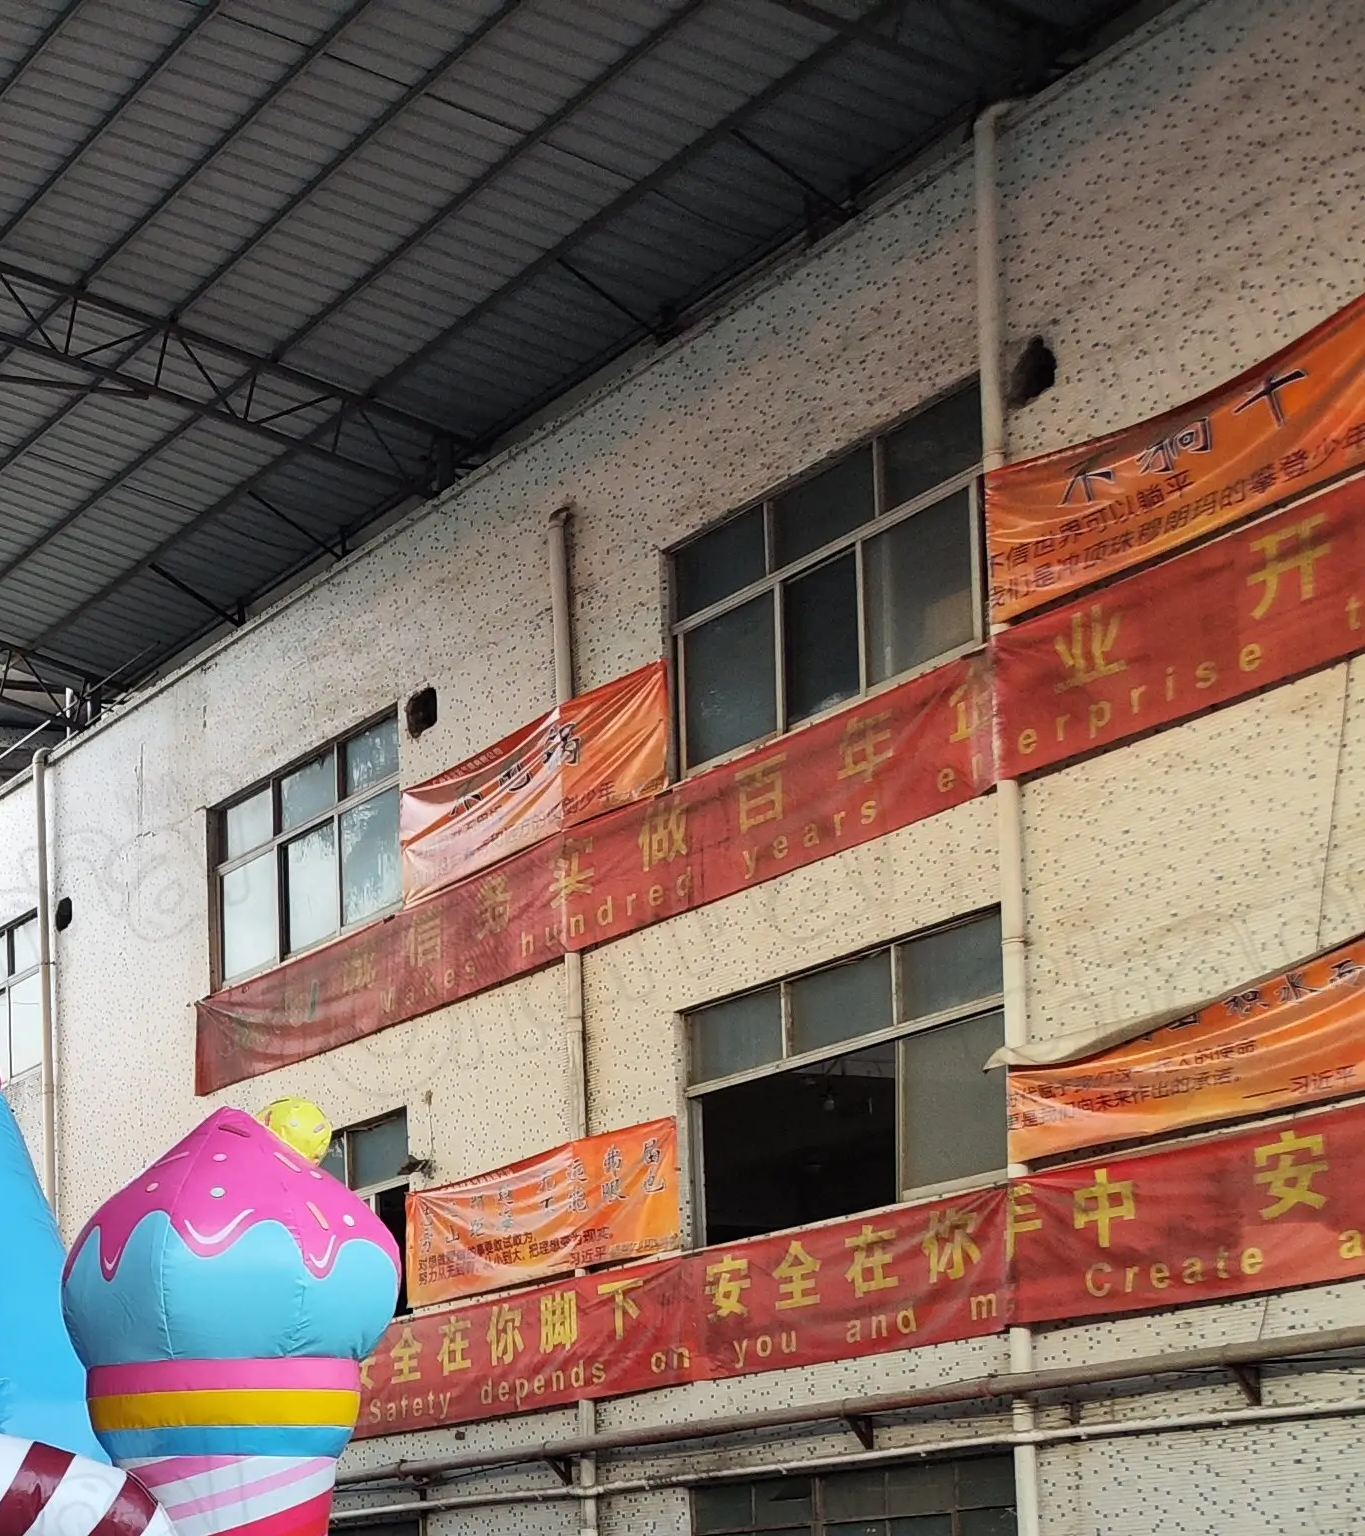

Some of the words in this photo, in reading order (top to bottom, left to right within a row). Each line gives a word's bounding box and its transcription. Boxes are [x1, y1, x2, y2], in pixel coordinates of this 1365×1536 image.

[519, 864, 695, 958] hundred
[741, 797, 880, 880] years
[936, 641, 1265, 793] enerprise
[1253, 1130, 1329, 1221] 安
[369, 1390, 451, 1424] Safety
[480, 1359, 607, 1407] depends
[650, 1345, 691, 1374] on
[733, 1328, 798, 1369] you
[845, 1308, 917, 1343] and
[1084, 1246, 1264, 1298] Create
